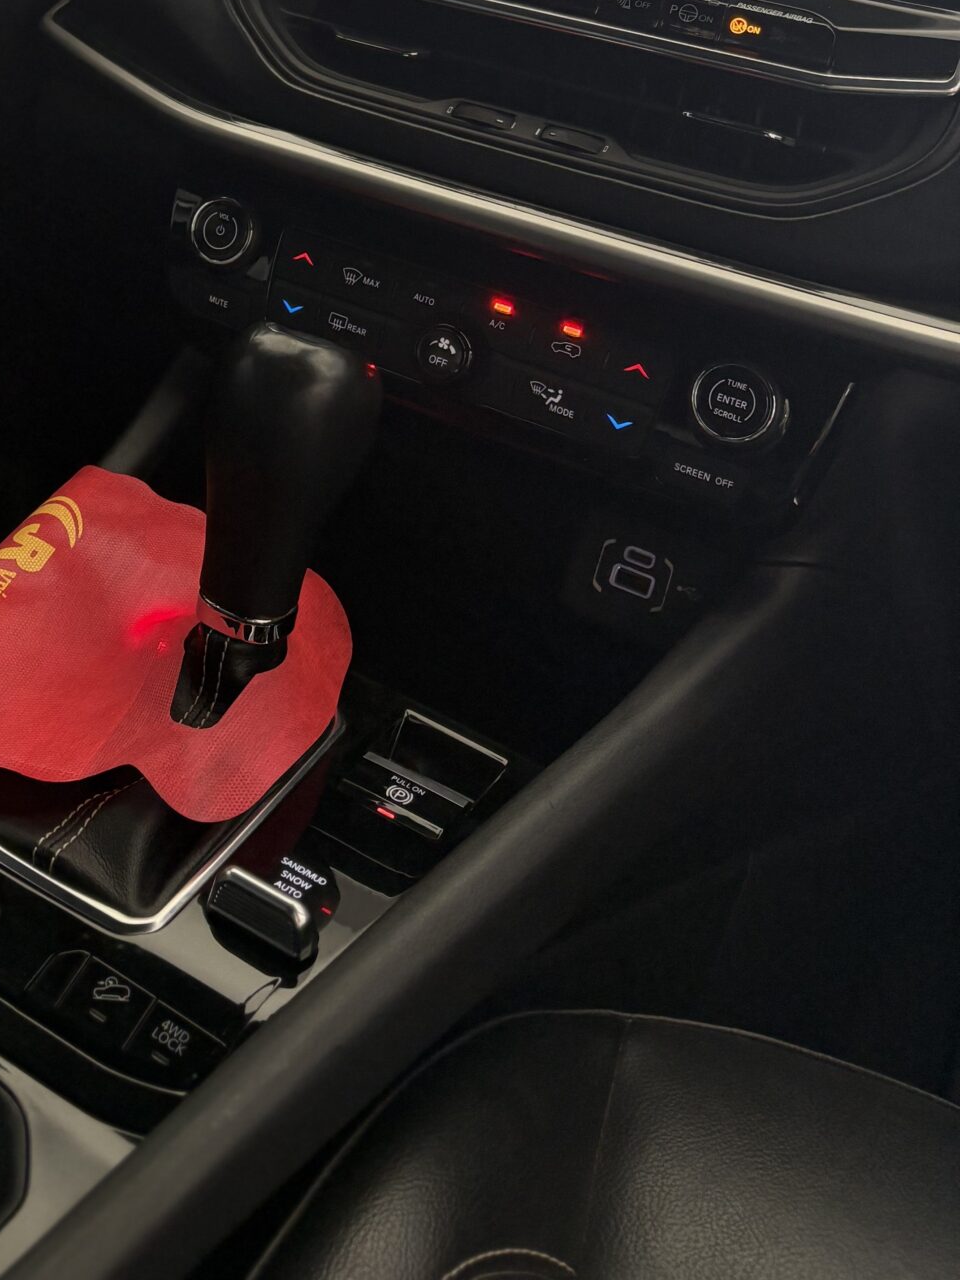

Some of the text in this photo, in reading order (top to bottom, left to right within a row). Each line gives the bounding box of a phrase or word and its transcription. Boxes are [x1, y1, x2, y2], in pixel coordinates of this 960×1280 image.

[634, 0, 653, 9] OFF
[698, 14, 714, 23] ON
[736, 2, 814, 24] PASSENGER AIRBAG
[746, 24, 761, 35] ON
[362, 276, 381, 289] MAX
[209, 295, 229, 308] MUTE
[413, 292, 436, 307] AUTO
[346, 322, 368, 337] REAR
[489, 319, 506, 331] A/C
[428, 354, 448, 368] OFF
[726, 378, 748, 392] TUNE
[716, 392, 748, 410] ENTER
[549, 404, 576, 420] MODE
[712, 406, 743, 424] SCROLL
[673, 462, 735, 489] SCREEN OFF
[391, 775, 426, 796] PULL ON
[280, 856, 328, 886] SAND/MUD
[280, 870, 313, 891] SNOW
[273, 880, 303, 899] AUTO
[161, 1019, 190, 1044] 4WD
[151, 1025, 189, 1057] LOCK
